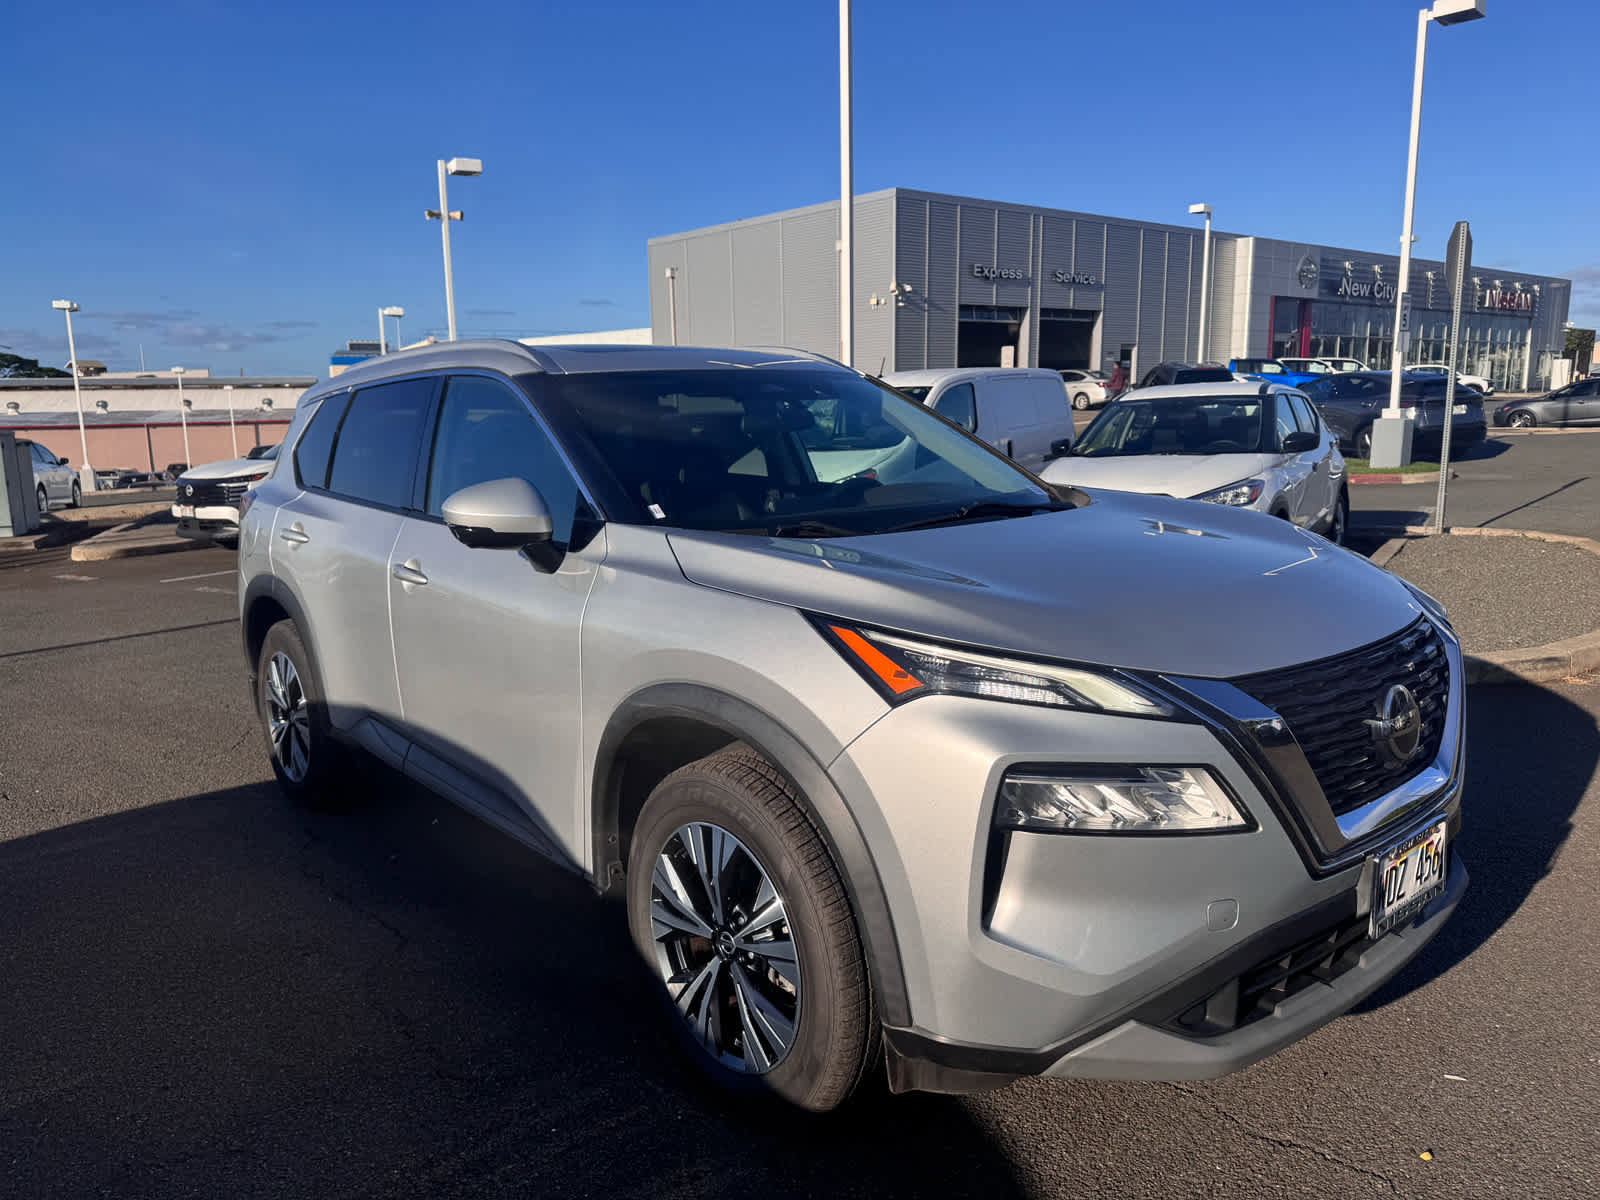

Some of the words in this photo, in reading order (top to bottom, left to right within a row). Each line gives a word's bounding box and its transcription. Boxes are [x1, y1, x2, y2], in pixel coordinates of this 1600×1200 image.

[973, 263, 1023, 280] Express
[1055, 270, 1096, 284] Service
[1341, 277, 1371, 297] New
[1374, 280, 1397, 303] City
[1484, 288, 1532, 311] NISSAN
[1416, 835, 1442, 885] 456
